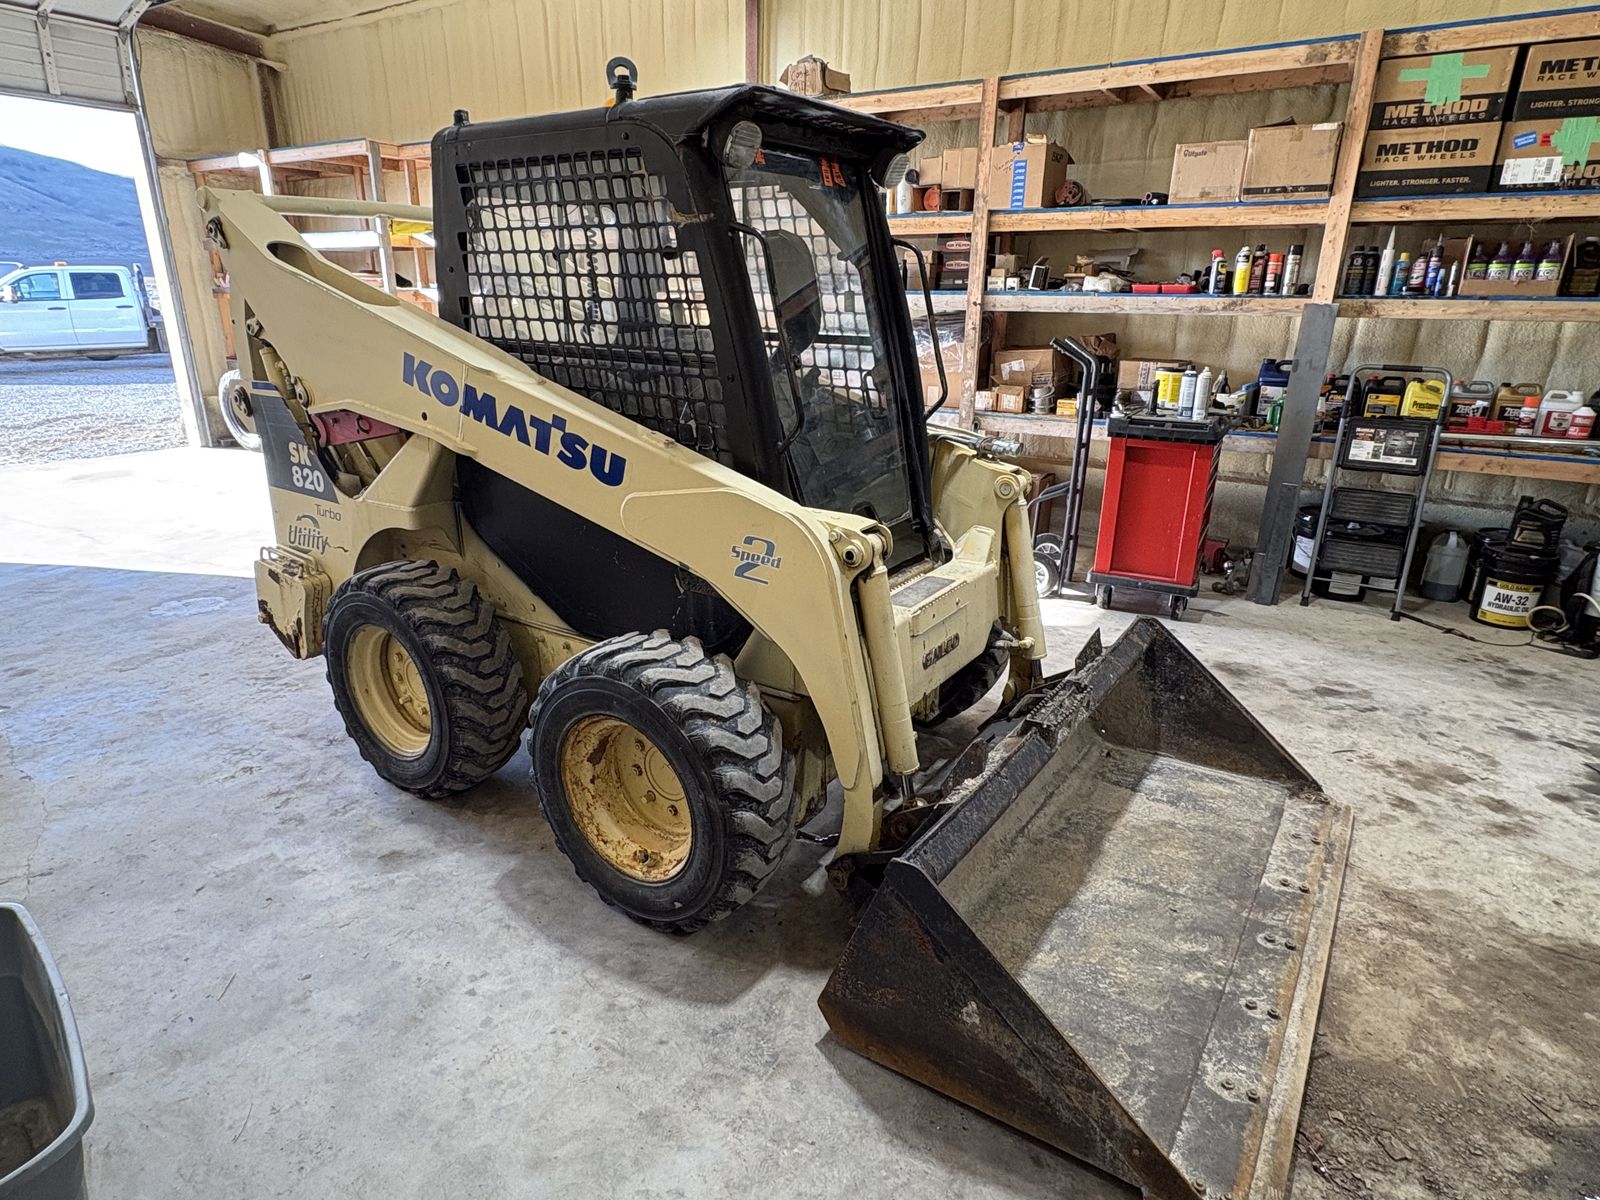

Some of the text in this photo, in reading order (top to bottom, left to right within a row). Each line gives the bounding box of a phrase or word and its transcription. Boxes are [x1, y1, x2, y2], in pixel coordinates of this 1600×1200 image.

[1539, 56, 1600, 75] MET
[1537, 73, 1577, 82] RACE
[1384, 98, 1489, 119] METHOD
[1530, 100, 1566, 109] LIGHTER.
[1382, 112, 1486, 126] RACE WHEELS
[1376, 138, 1480, 157] METHOD
[1375, 151, 1477, 164] RACE WHEELS
[1401, 178, 1440, 186] STRONGER.
[1441, 176, 1471, 185] FASTER.
[1412, 400, 1439, 411] Prestone
[1456, 404, 1471, 414] ZER
[1504, 407, 1520, 418] ZER
[403, 351, 627, 487] KOMATSU
[288, 441, 312, 466] SK
[291, 465, 325, 493] 820
[315, 504, 342, 522] Turbo
[288, 524, 334, 555] Utility
[731, 545, 782, 569] Speed
[1494, 592, 1529, 606] AW-32
[1487, 601, 1521, 613] HYDRAULIC
